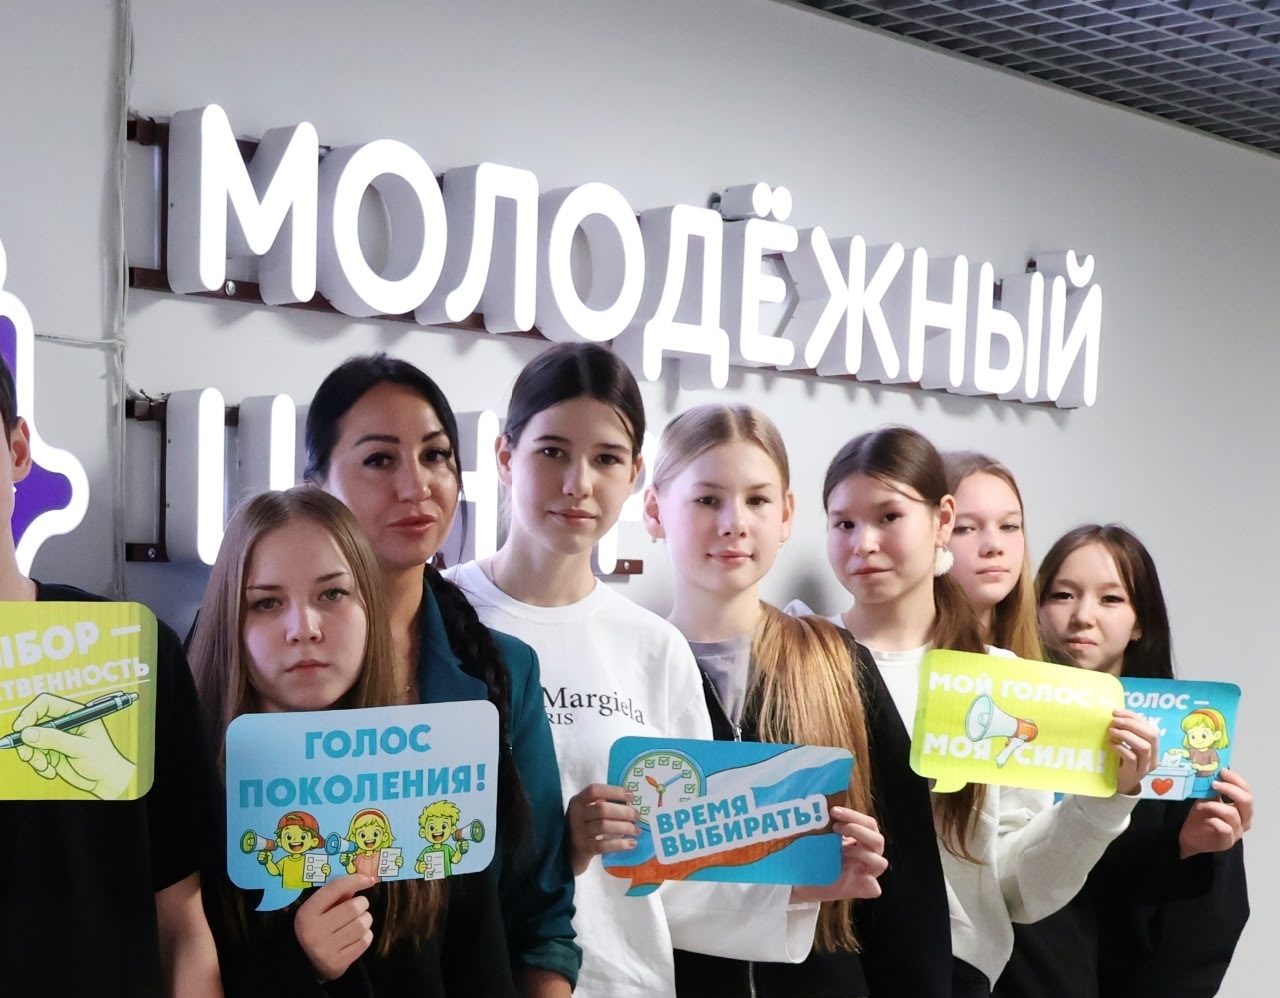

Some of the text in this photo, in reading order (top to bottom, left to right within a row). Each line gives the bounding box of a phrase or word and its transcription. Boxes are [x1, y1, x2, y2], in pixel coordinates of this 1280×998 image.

[198, 103, 1104, 407] МОЛОДЁЖНЫЙ
[541, 686, 645, 725] Margiela
[929, 671, 993, 695] МОЙ
[1001, 679, 1093, 707] ГОЛОС
[547, 712, 574, 725] RIS
[304, 723, 432, 760] ГОЛОС
[923, 732, 1107, 774] МОЯ СИЛА!
[239, 763, 486, 809] ПОКОЛЕНИЯ!
[656, 793, 750, 835] ВРЕМЯ
[661, 801, 824, 858] ВЫБИРАТЬ!
